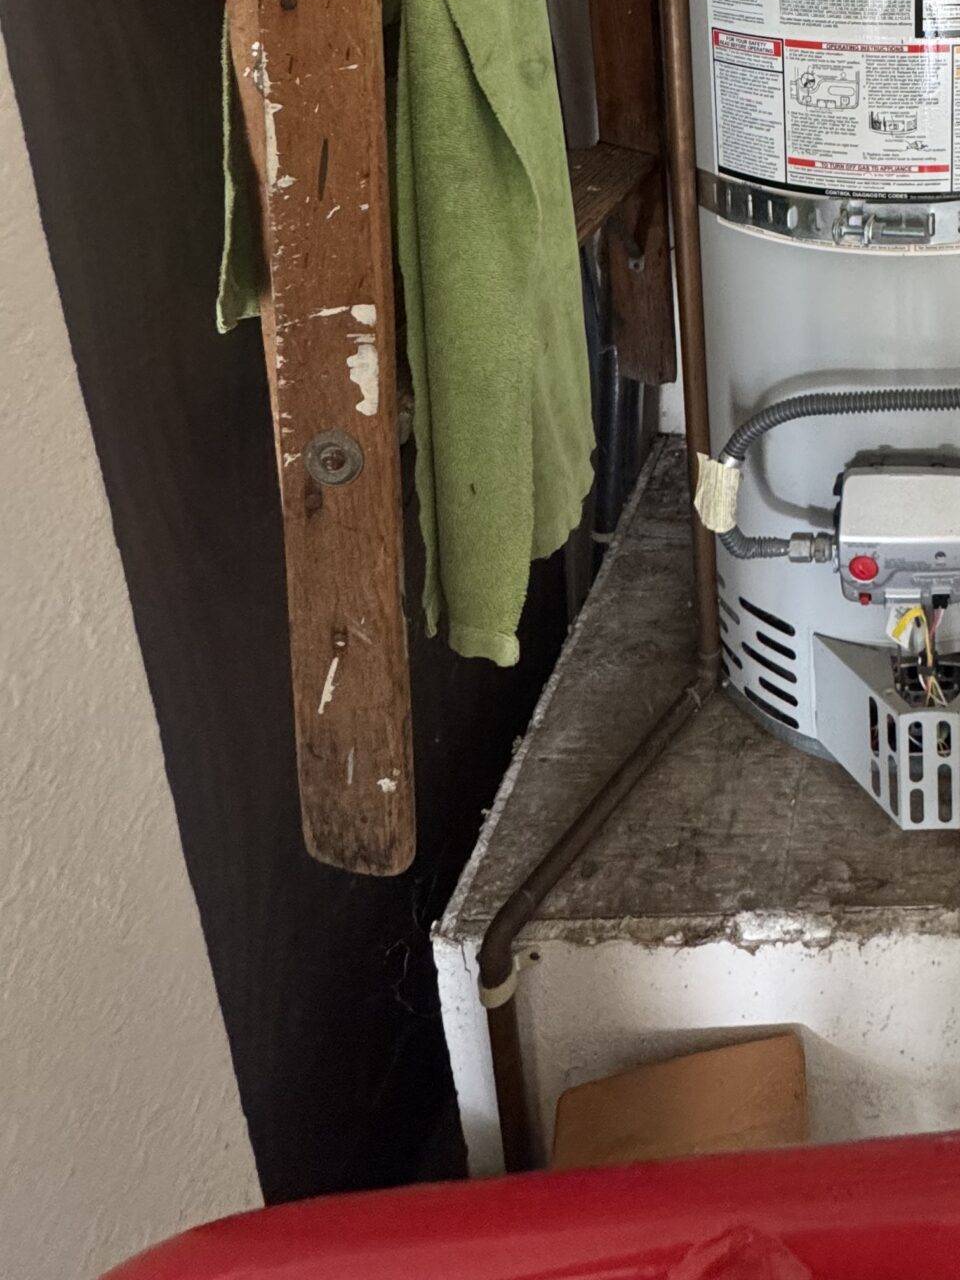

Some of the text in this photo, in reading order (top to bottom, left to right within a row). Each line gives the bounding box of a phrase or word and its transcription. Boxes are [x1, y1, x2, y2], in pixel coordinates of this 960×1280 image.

[735, 36, 747, 44] YOUR
[749, 39, 766, 47] SAFETY
[826, 43, 859, 51] OPERATING
[825, 189, 850, 197] CONTROL
[852, 191, 886, 199] DIAGNOSTIC
